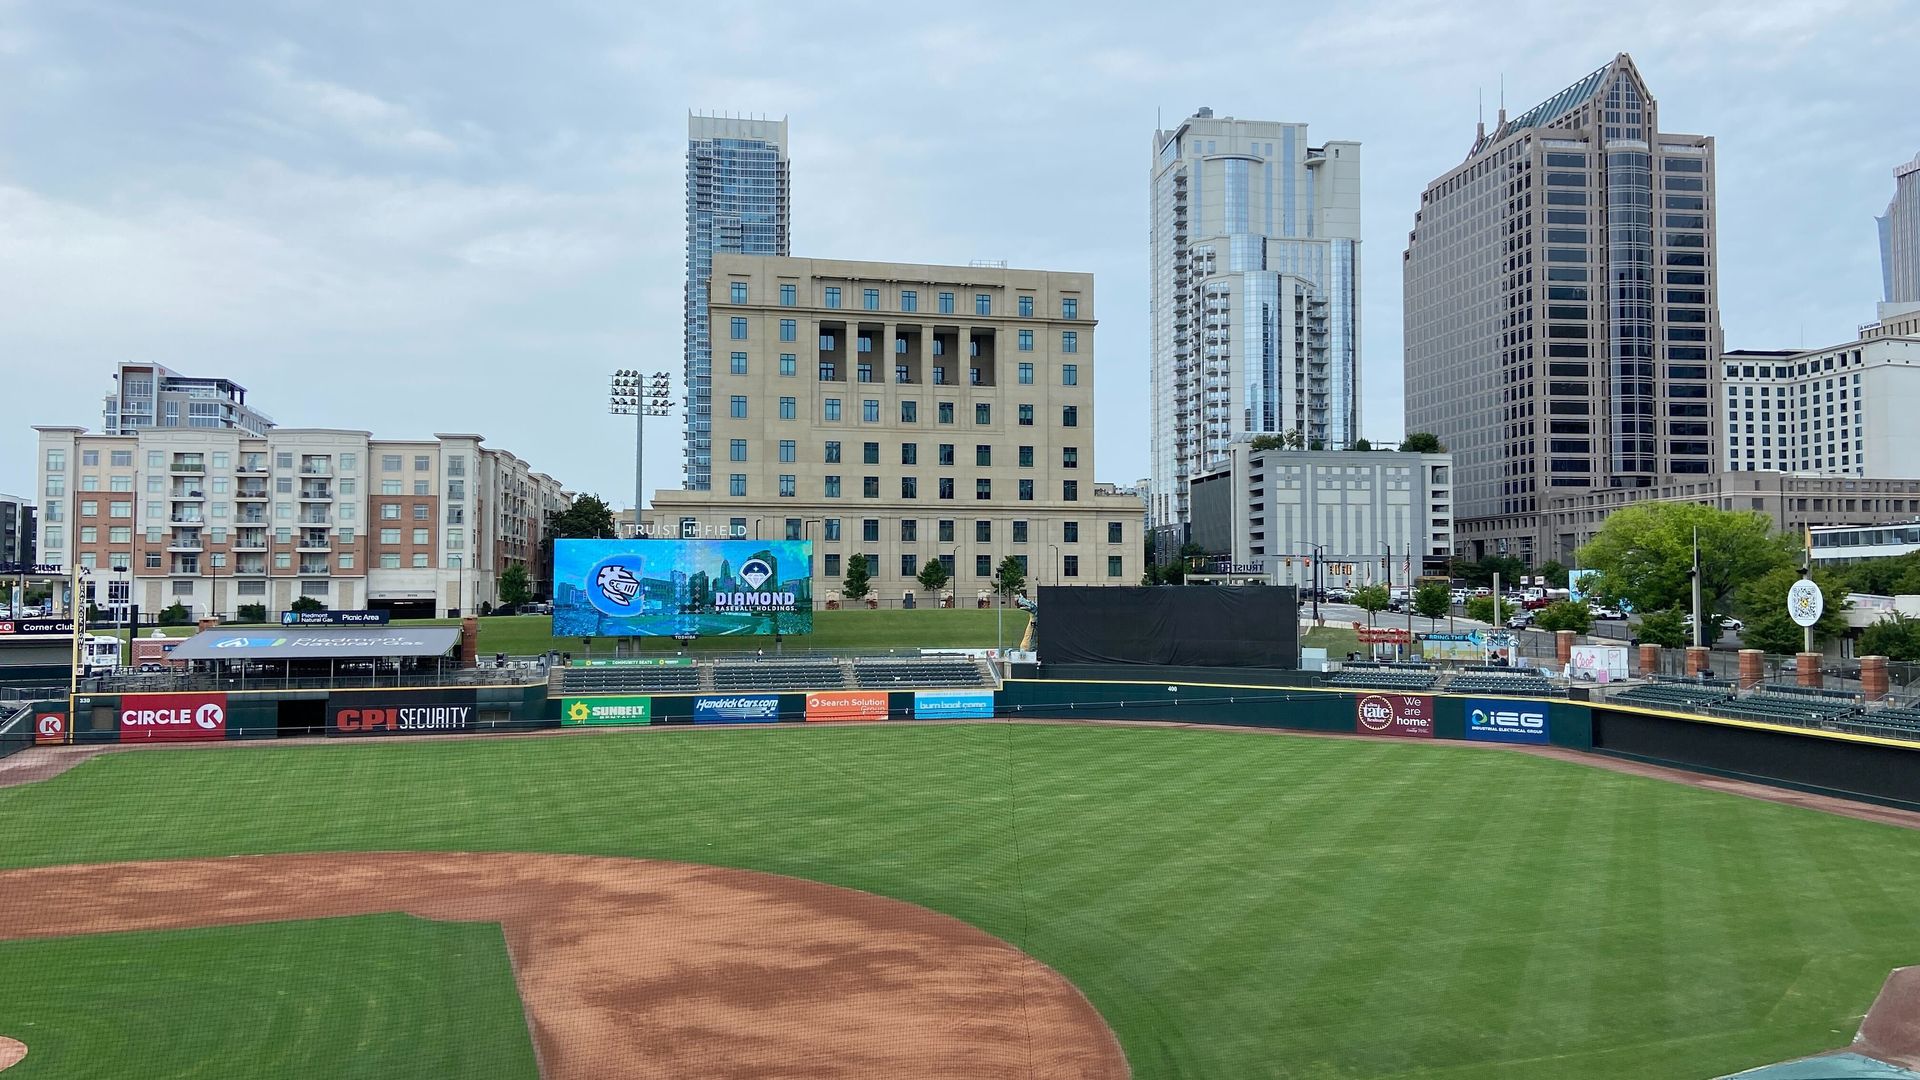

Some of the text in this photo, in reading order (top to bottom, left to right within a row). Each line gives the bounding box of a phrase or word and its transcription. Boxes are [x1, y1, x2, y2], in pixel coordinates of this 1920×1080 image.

[625, 524, 747, 536] TRUIST FIELD
[715, 592, 795, 605] DIAMOND
[1429, 633, 1450, 641] BRING
[820, 698, 885, 707] Search Solution
[920, 701, 941, 709] burn
[1403, 697, 1421, 706] We
[1363, 704, 1390, 718] tate
[1404, 708, 1421, 716] are
[122, 709, 191, 726] CIRCLE
[337, 707, 468, 731] CPI SECURITY
